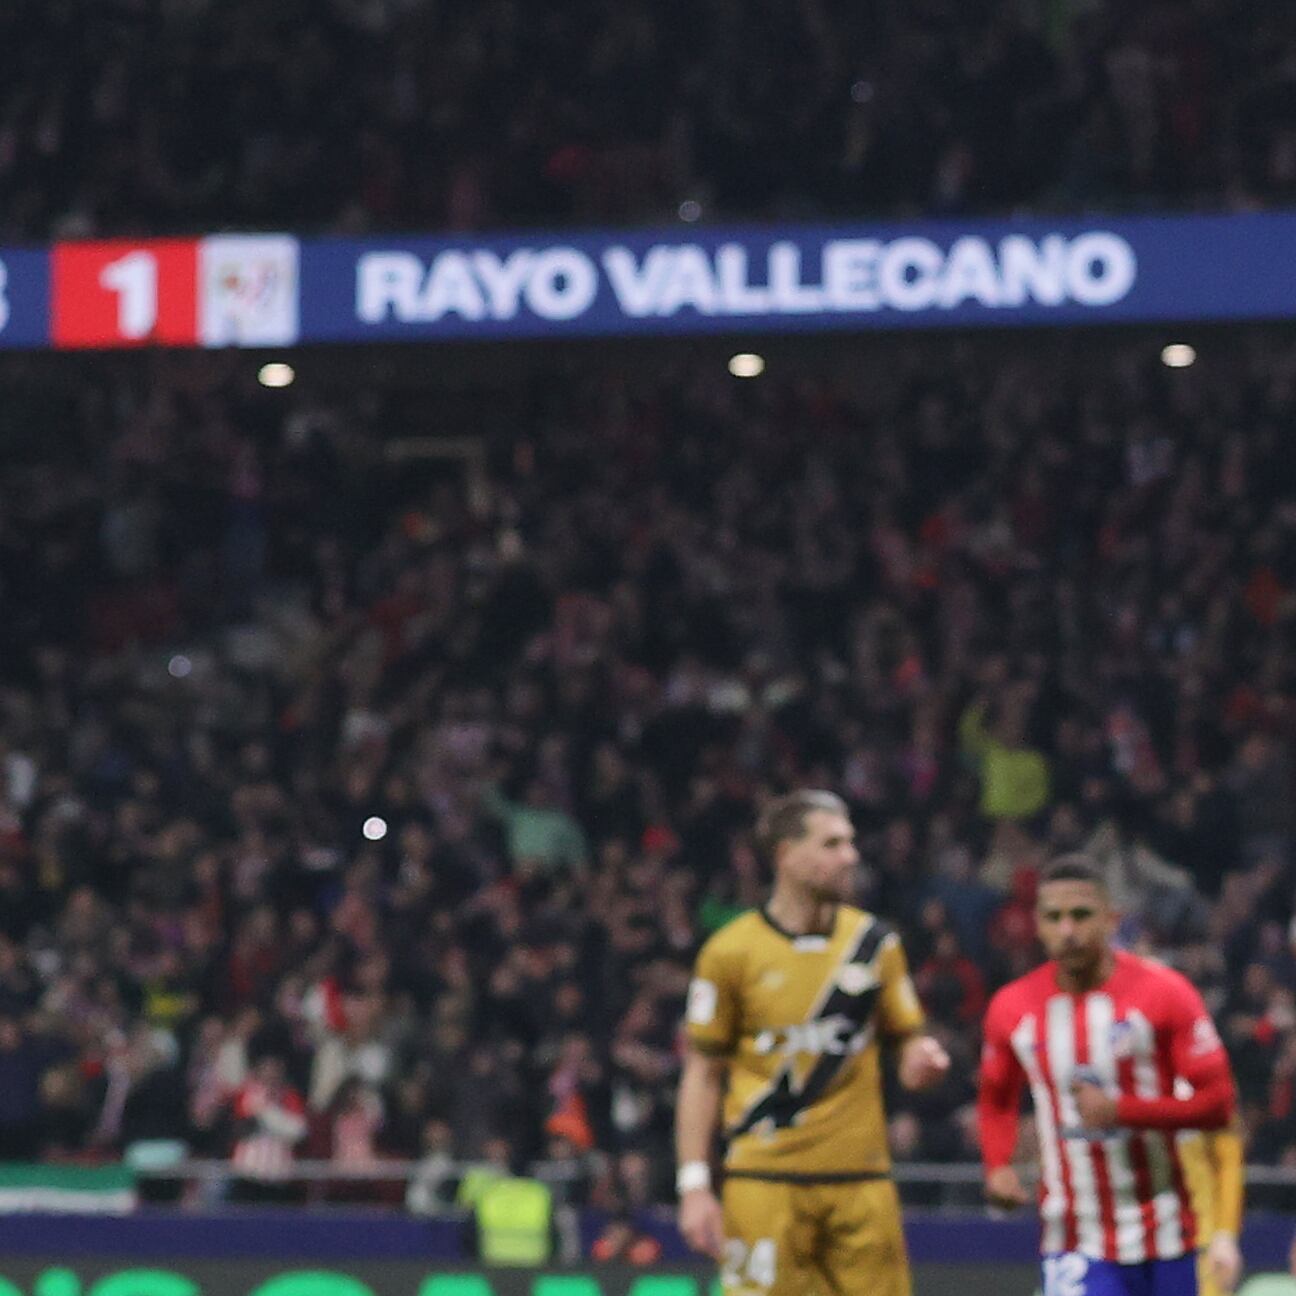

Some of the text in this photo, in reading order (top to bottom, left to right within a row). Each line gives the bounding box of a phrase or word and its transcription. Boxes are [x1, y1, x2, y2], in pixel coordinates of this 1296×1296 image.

[100, 250, 157, 339] 1
[358, 231, 1136, 322] RAYO VALLECANO
